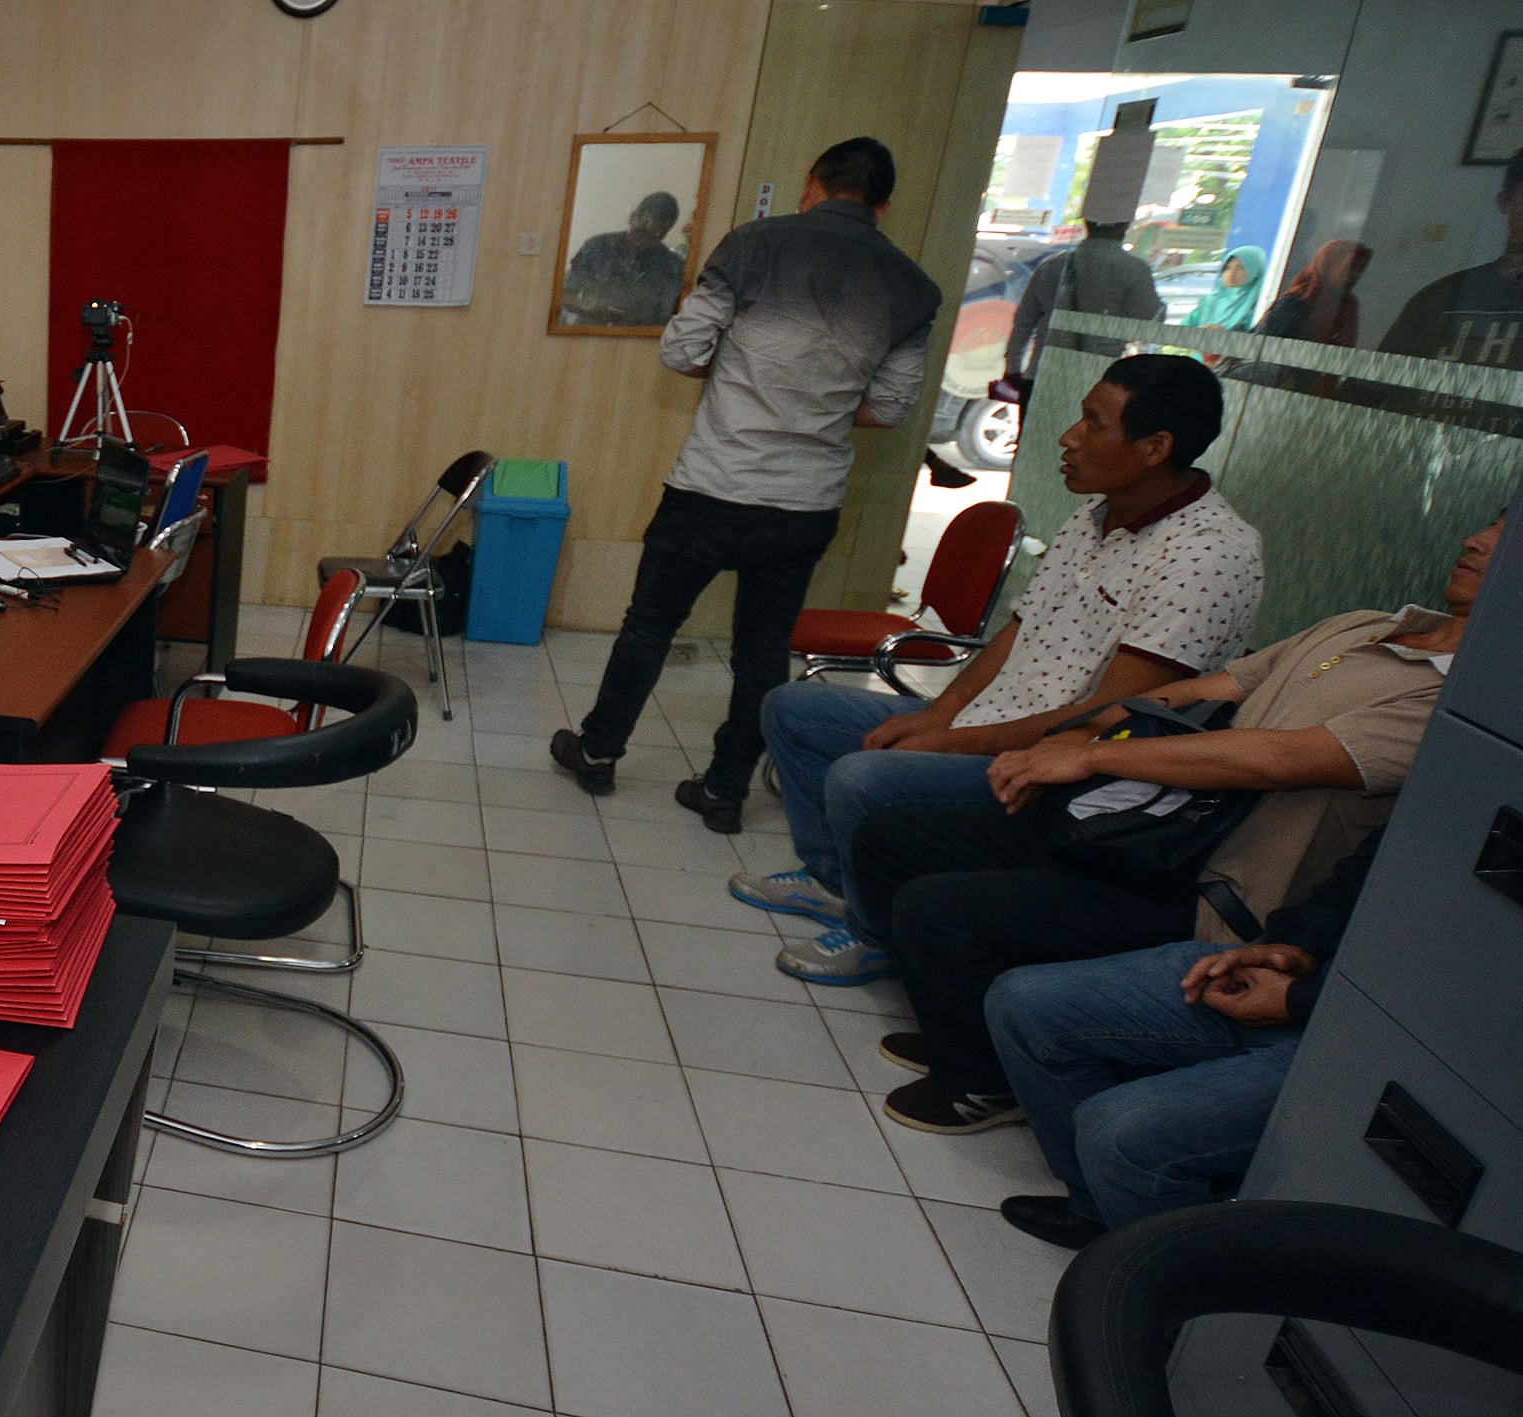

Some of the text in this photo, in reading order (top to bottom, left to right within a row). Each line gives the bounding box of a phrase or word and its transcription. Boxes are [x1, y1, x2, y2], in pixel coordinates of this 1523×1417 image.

[420, 208, 430, 220] 12
[433, 208, 443, 220] 19
[446, 208, 458, 220] 26
[419, 223, 428, 233] 13
[431, 223, 442, 233] 20
[444, 223, 456, 233] 27
[417, 236, 426, 246] 14
[431, 236, 440, 246] 21
[443, 236, 455, 246] 28
[428, 249, 439, 260] 22
[427, 262, 438, 273] 23
[425, 275, 436, 286] 24
[423, 289, 435, 299] 25
